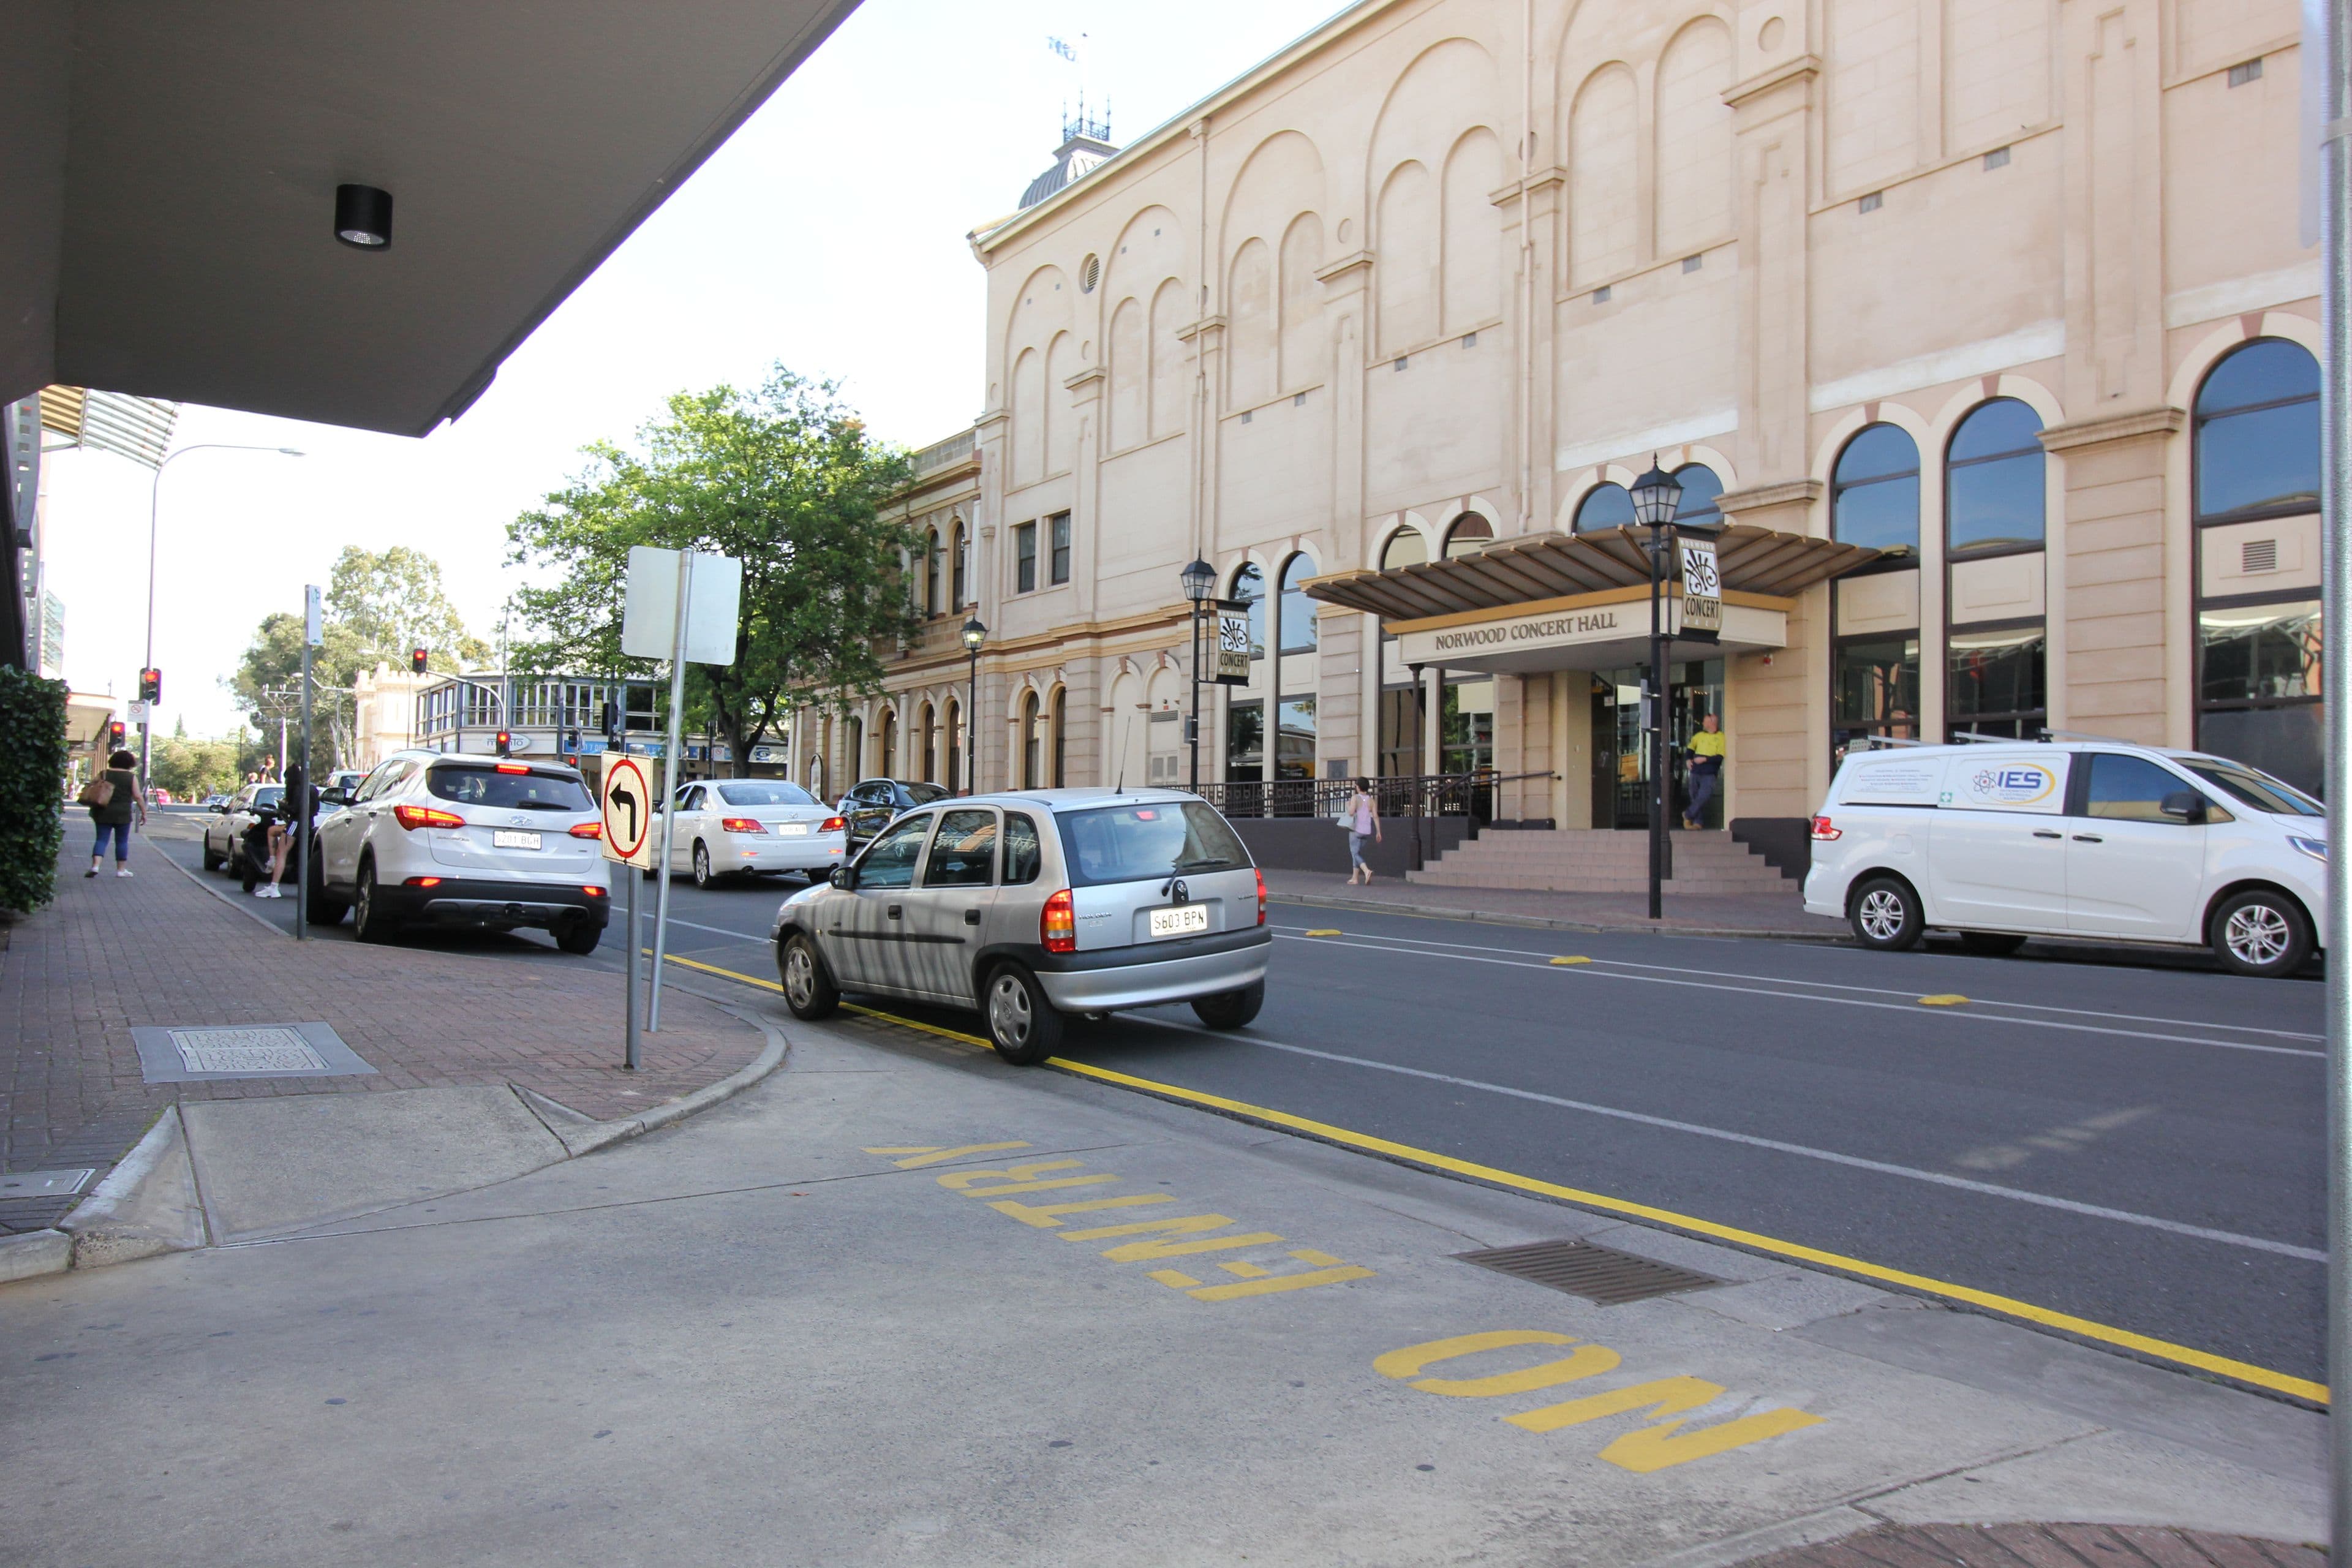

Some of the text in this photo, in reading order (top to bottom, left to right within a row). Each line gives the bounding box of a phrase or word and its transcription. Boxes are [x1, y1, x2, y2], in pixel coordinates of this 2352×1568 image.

[1686, 597, 1719, 619] CONCERT
[1436, 612, 1617, 650] NORWOOD CONCERT HALL
[1220, 653, 1248, 668] CONCERT
[1997, 771, 2042, 789] IES
[1155, 911, 1204, 929] S603 BPN
[860, 1140, 1828, 1472] NO ENTRY
